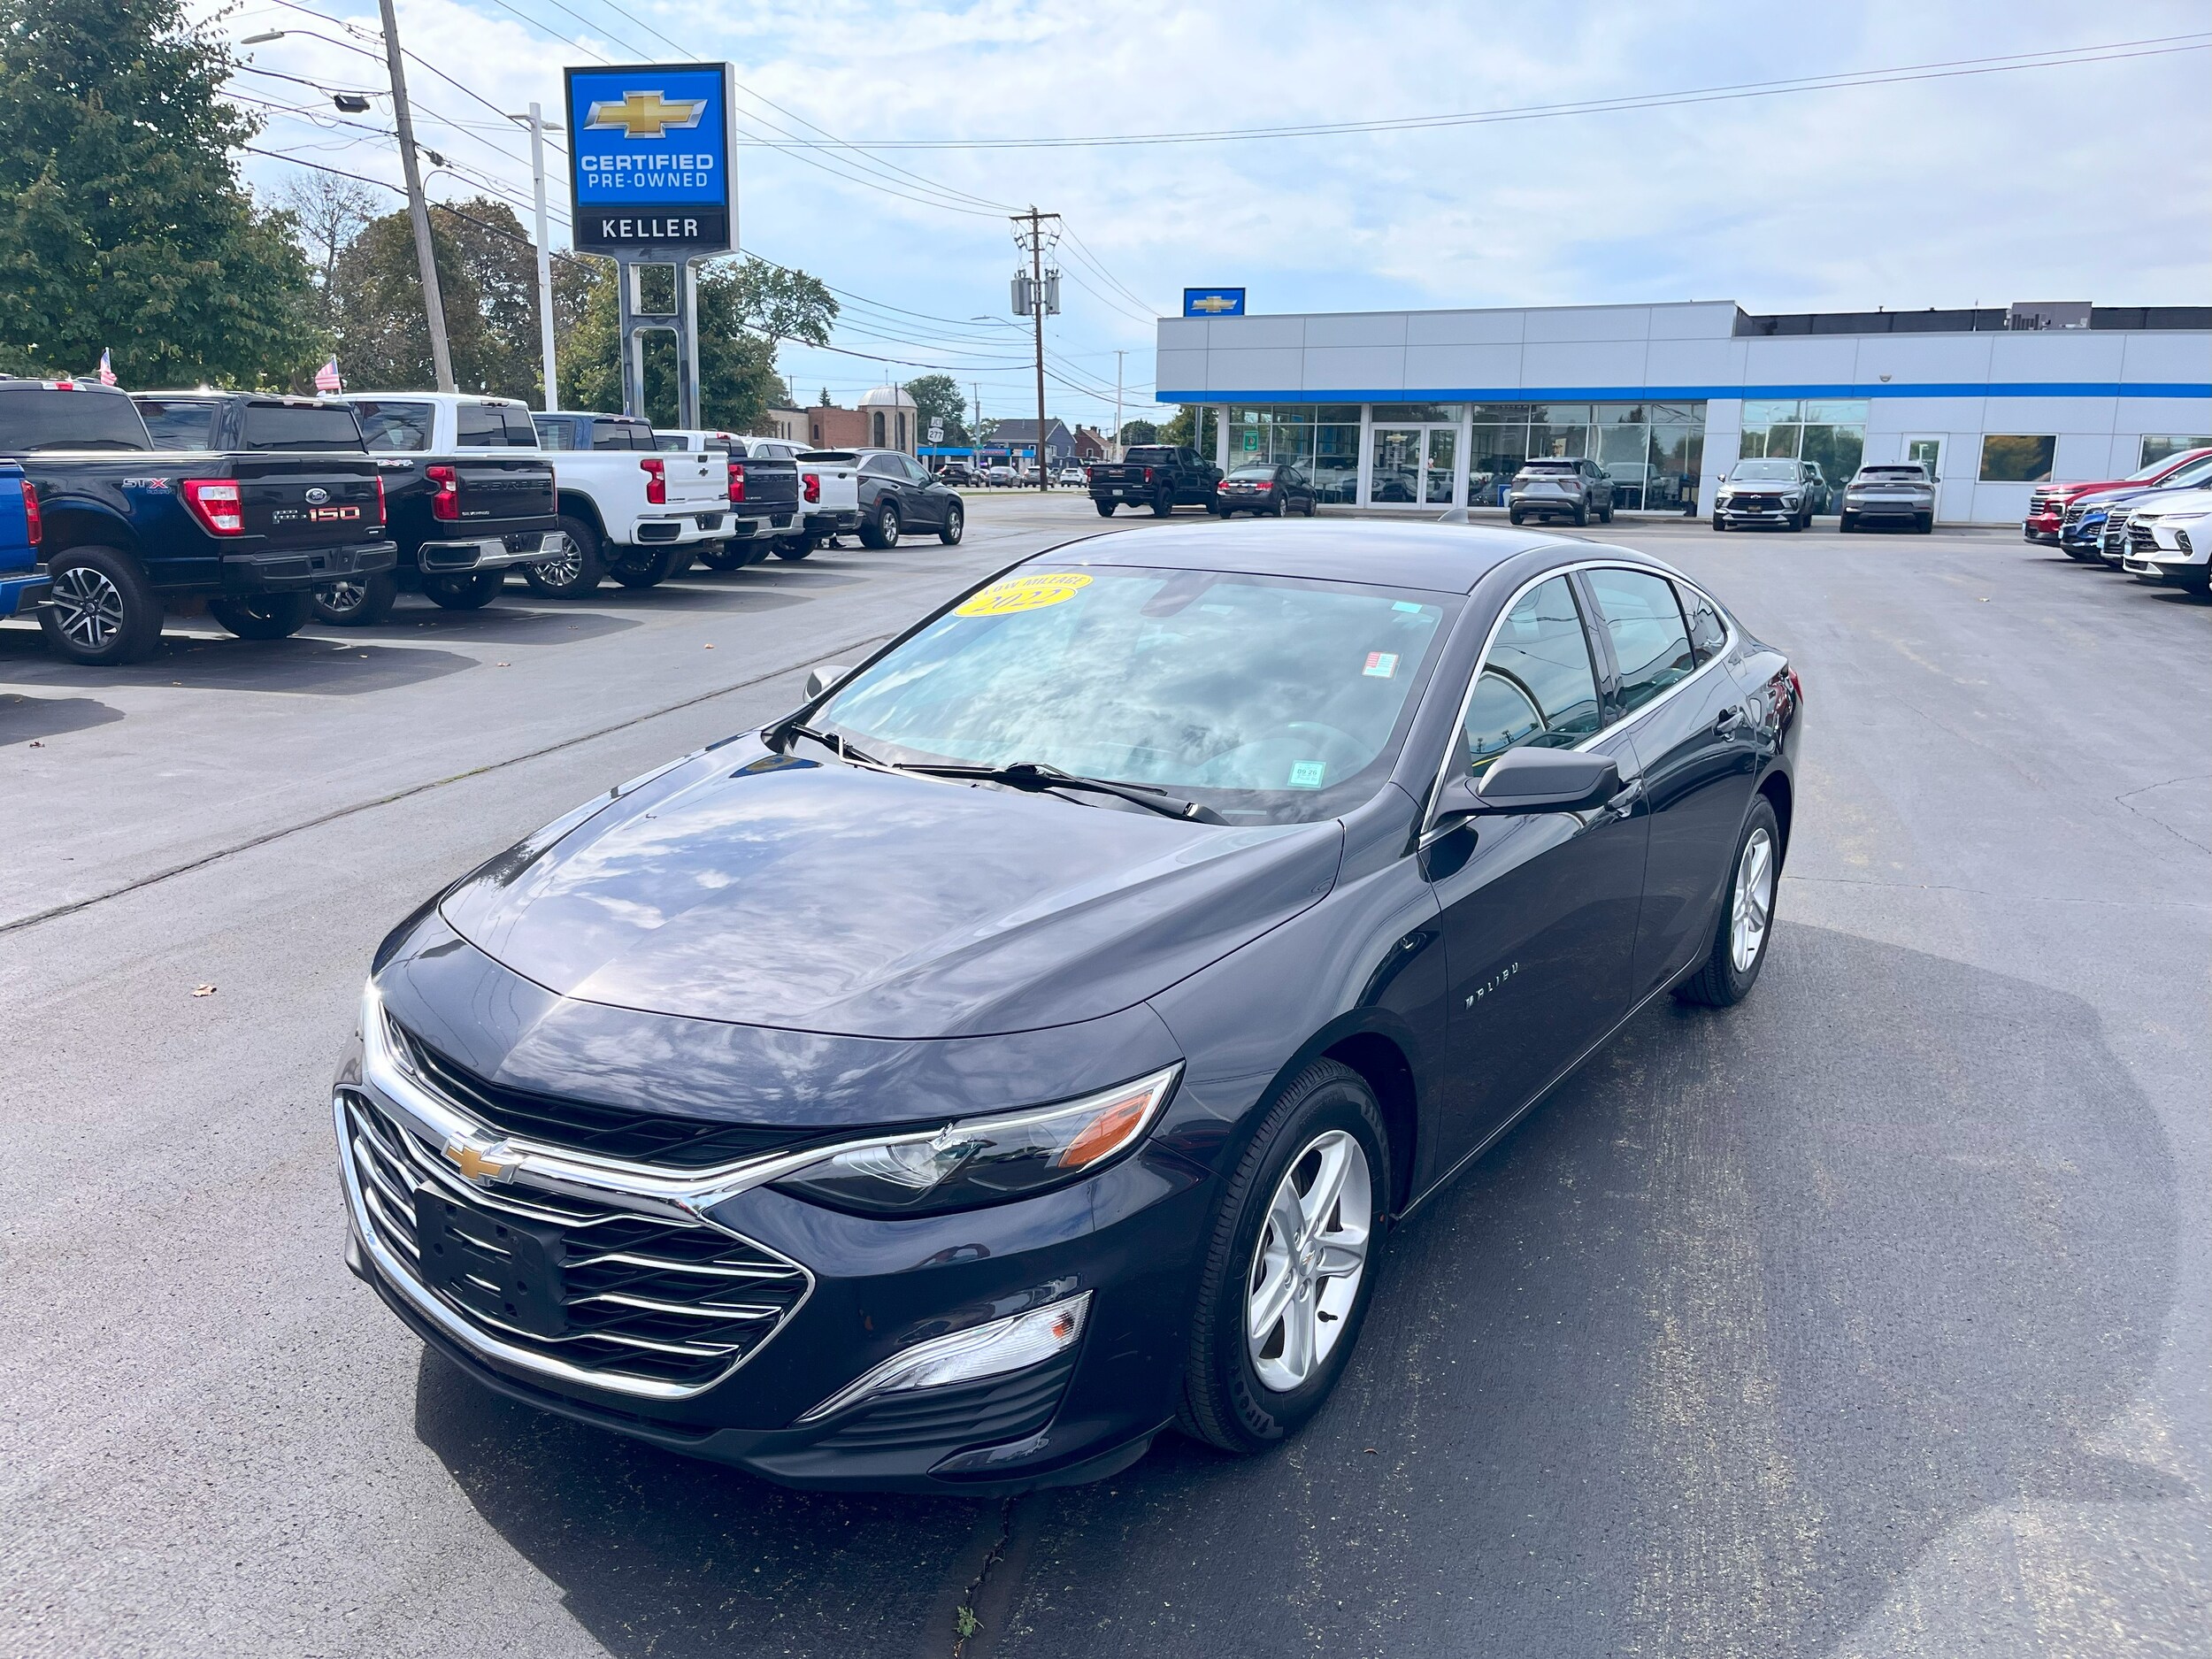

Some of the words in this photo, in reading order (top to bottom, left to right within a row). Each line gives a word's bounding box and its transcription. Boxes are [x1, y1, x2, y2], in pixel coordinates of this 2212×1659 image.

[580, 154, 714, 171] CERTIFIED
[588, 173, 708, 188] PRE-OWNED
[603, 219, 698, 238] KELLER
[122, 478, 171, 488] STX
[984, 581, 1020, 595] LOW
[1023, 576, 1087, 587] MILEAGE
[971, 588, 1062, 612] 2022
[1465, 962, 1518, 1010] MALIBU
